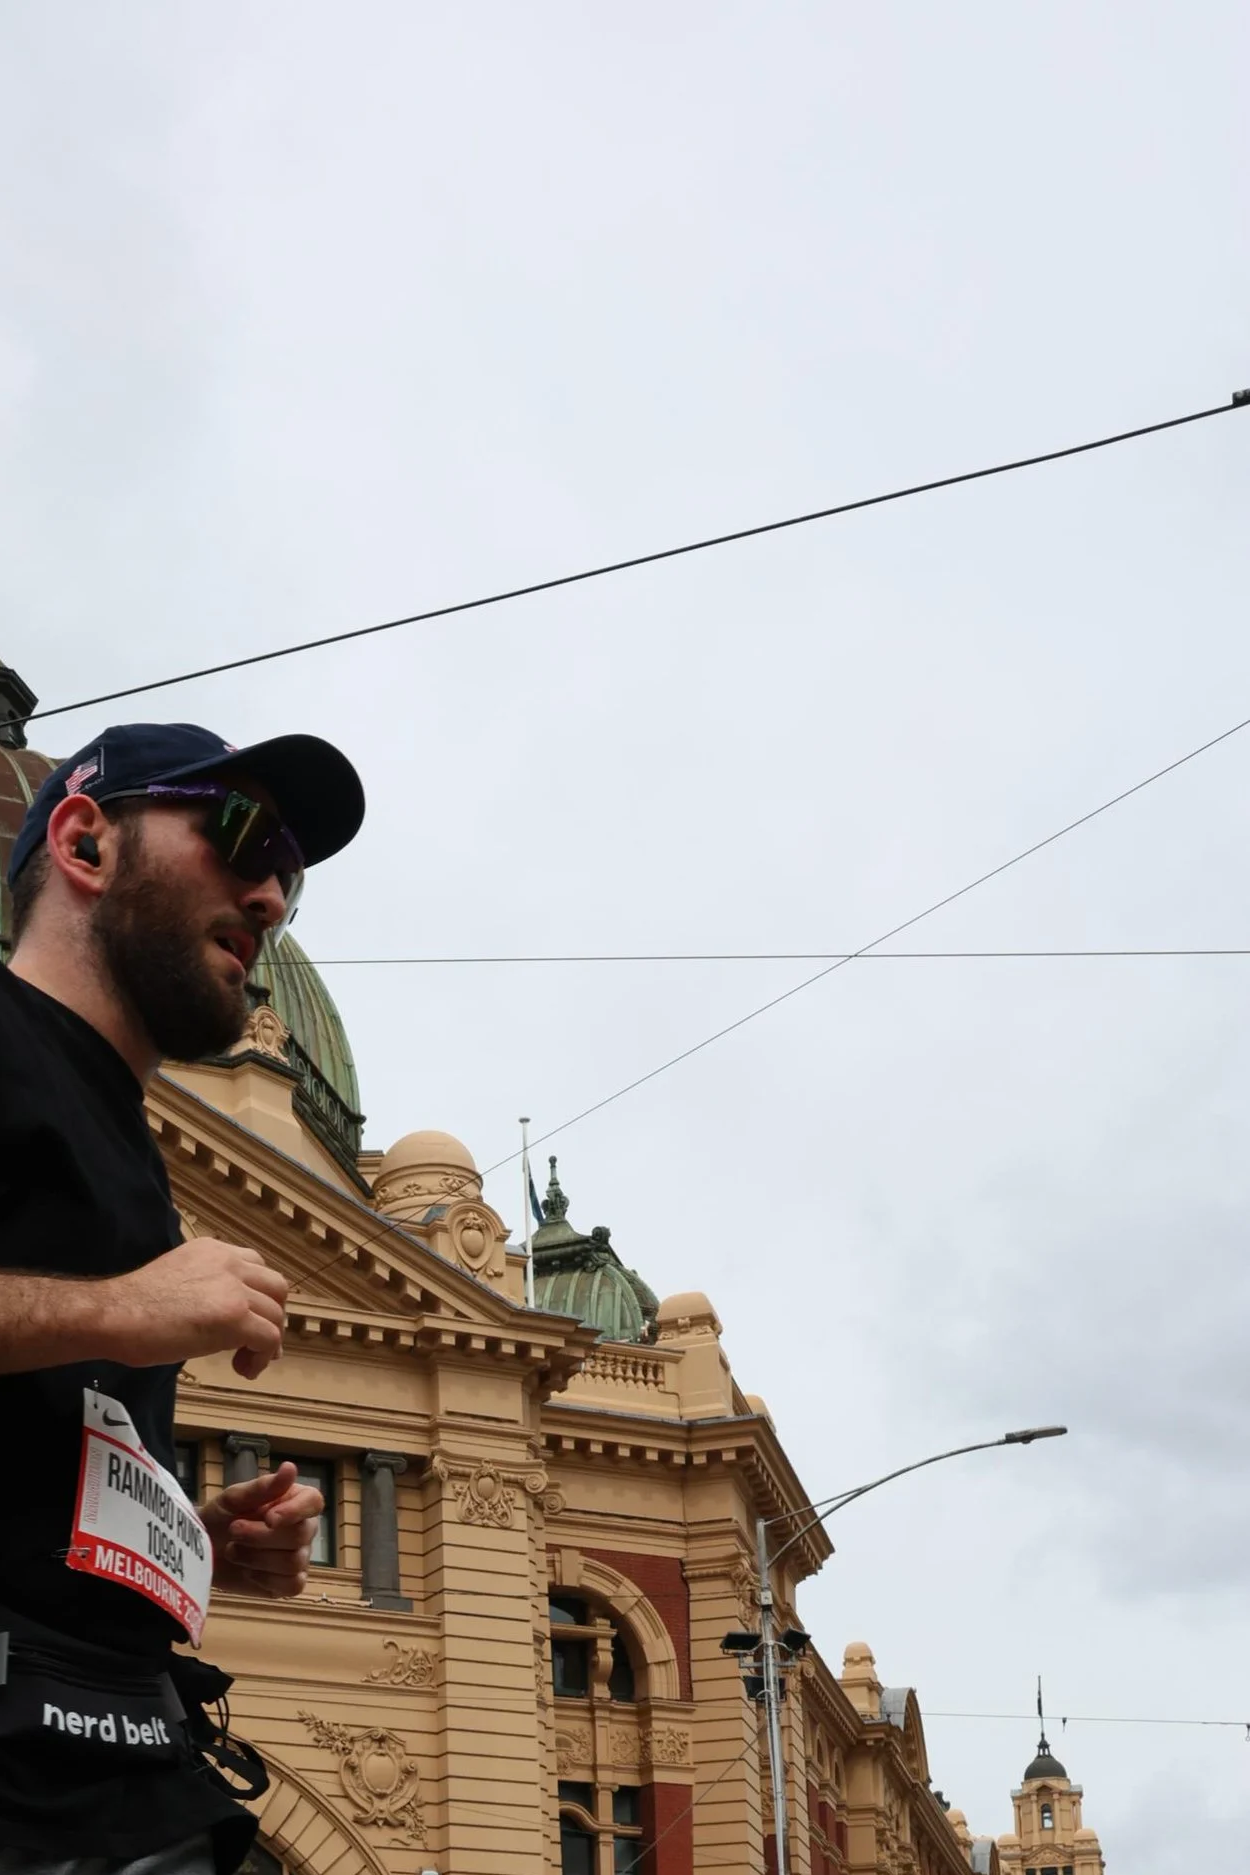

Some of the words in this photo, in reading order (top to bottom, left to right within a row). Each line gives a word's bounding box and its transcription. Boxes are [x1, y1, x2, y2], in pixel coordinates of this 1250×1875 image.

[107, 1452, 175, 1530] RAMMBO
[93, 1544, 183, 1615] MELBOURNE
[146, 1520, 184, 1581] 10994
[42, 1703, 118, 1743] nerd
[121, 1715, 171, 1745] belt
